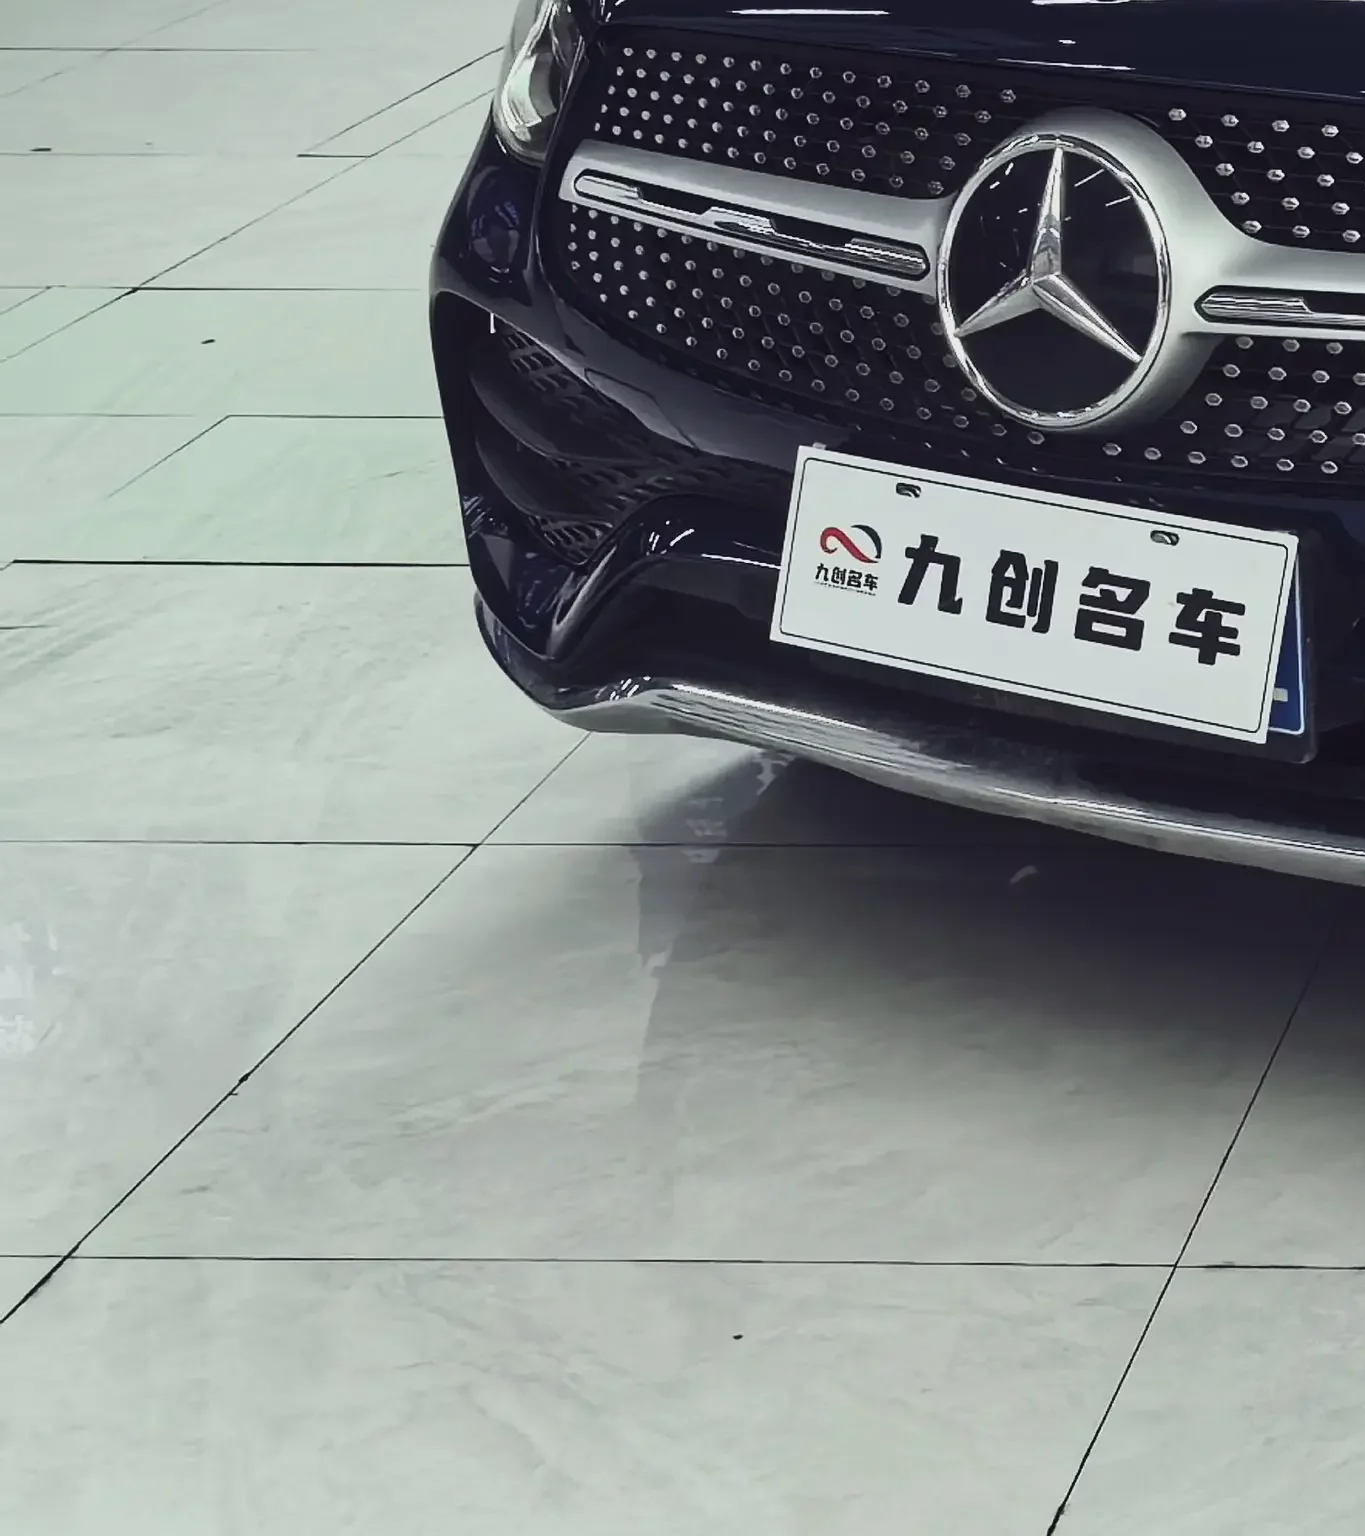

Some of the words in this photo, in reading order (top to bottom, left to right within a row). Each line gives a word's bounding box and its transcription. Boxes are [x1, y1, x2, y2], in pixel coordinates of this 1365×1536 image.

[815, 562, 879, 591] 九创名车
[897, 533, 1246, 666] 九创名车
